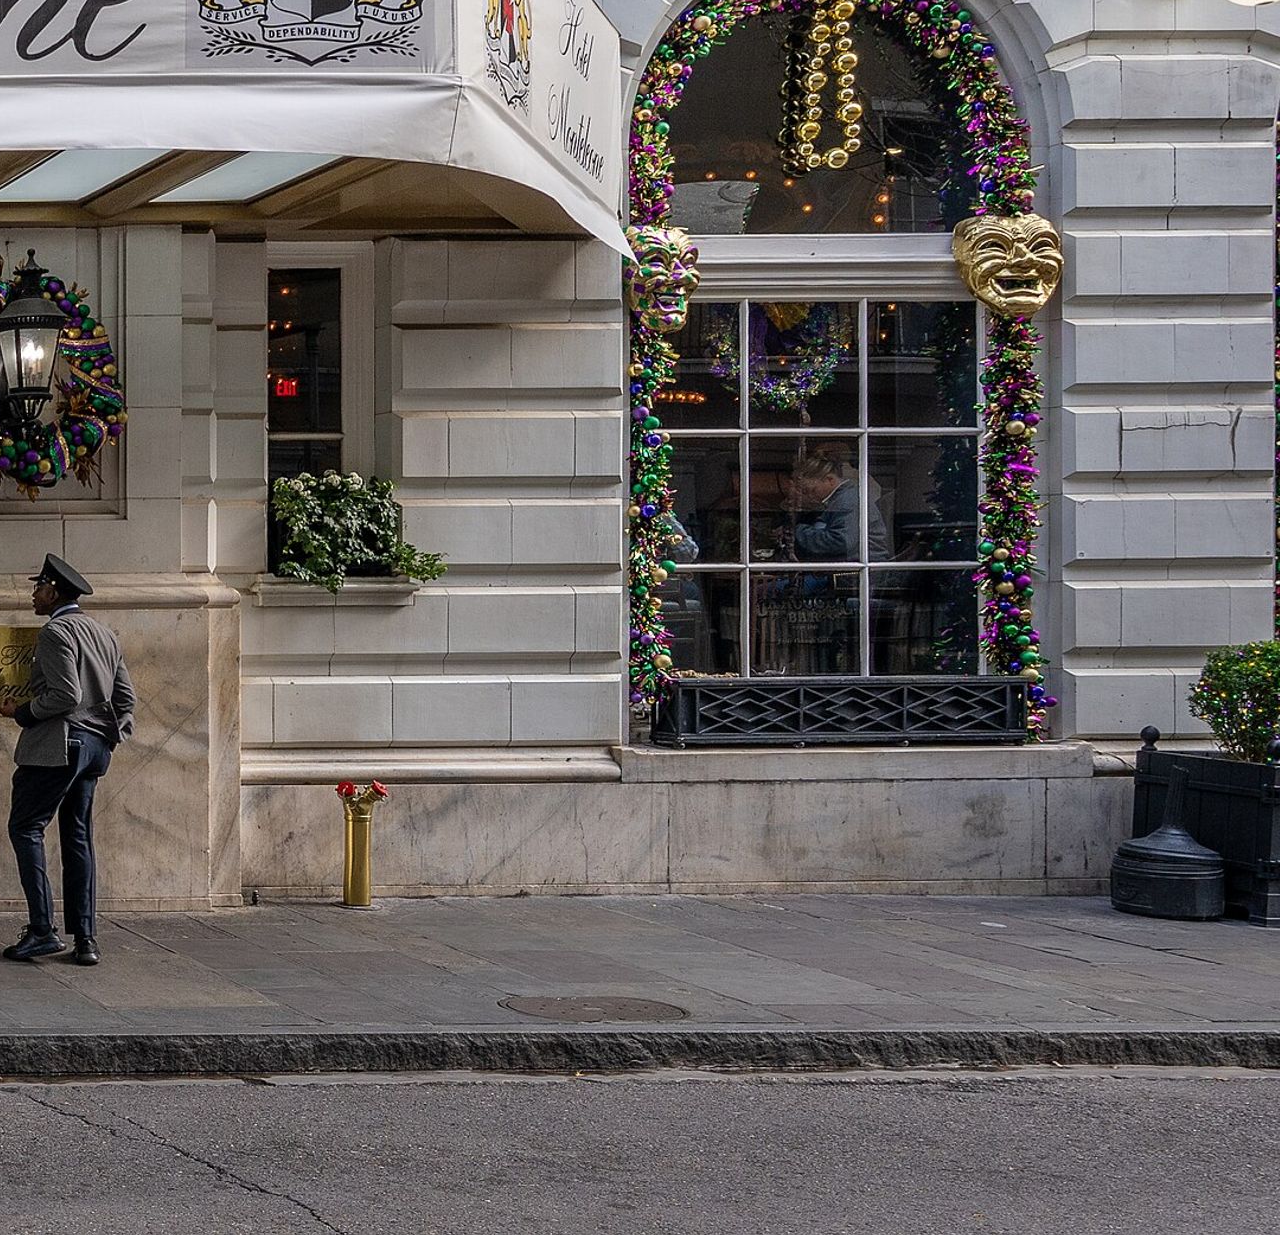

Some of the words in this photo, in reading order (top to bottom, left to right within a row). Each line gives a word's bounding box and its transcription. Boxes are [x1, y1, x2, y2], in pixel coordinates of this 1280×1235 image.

[206, 6, 259, 21] SERVICE
[363, 6, 416, 22] LUXURY
[268, 26, 356, 39] DEPENDABILITY
[547, 82, 605, 183] Monteleone
[276, 379, 297, 397] EXIT
